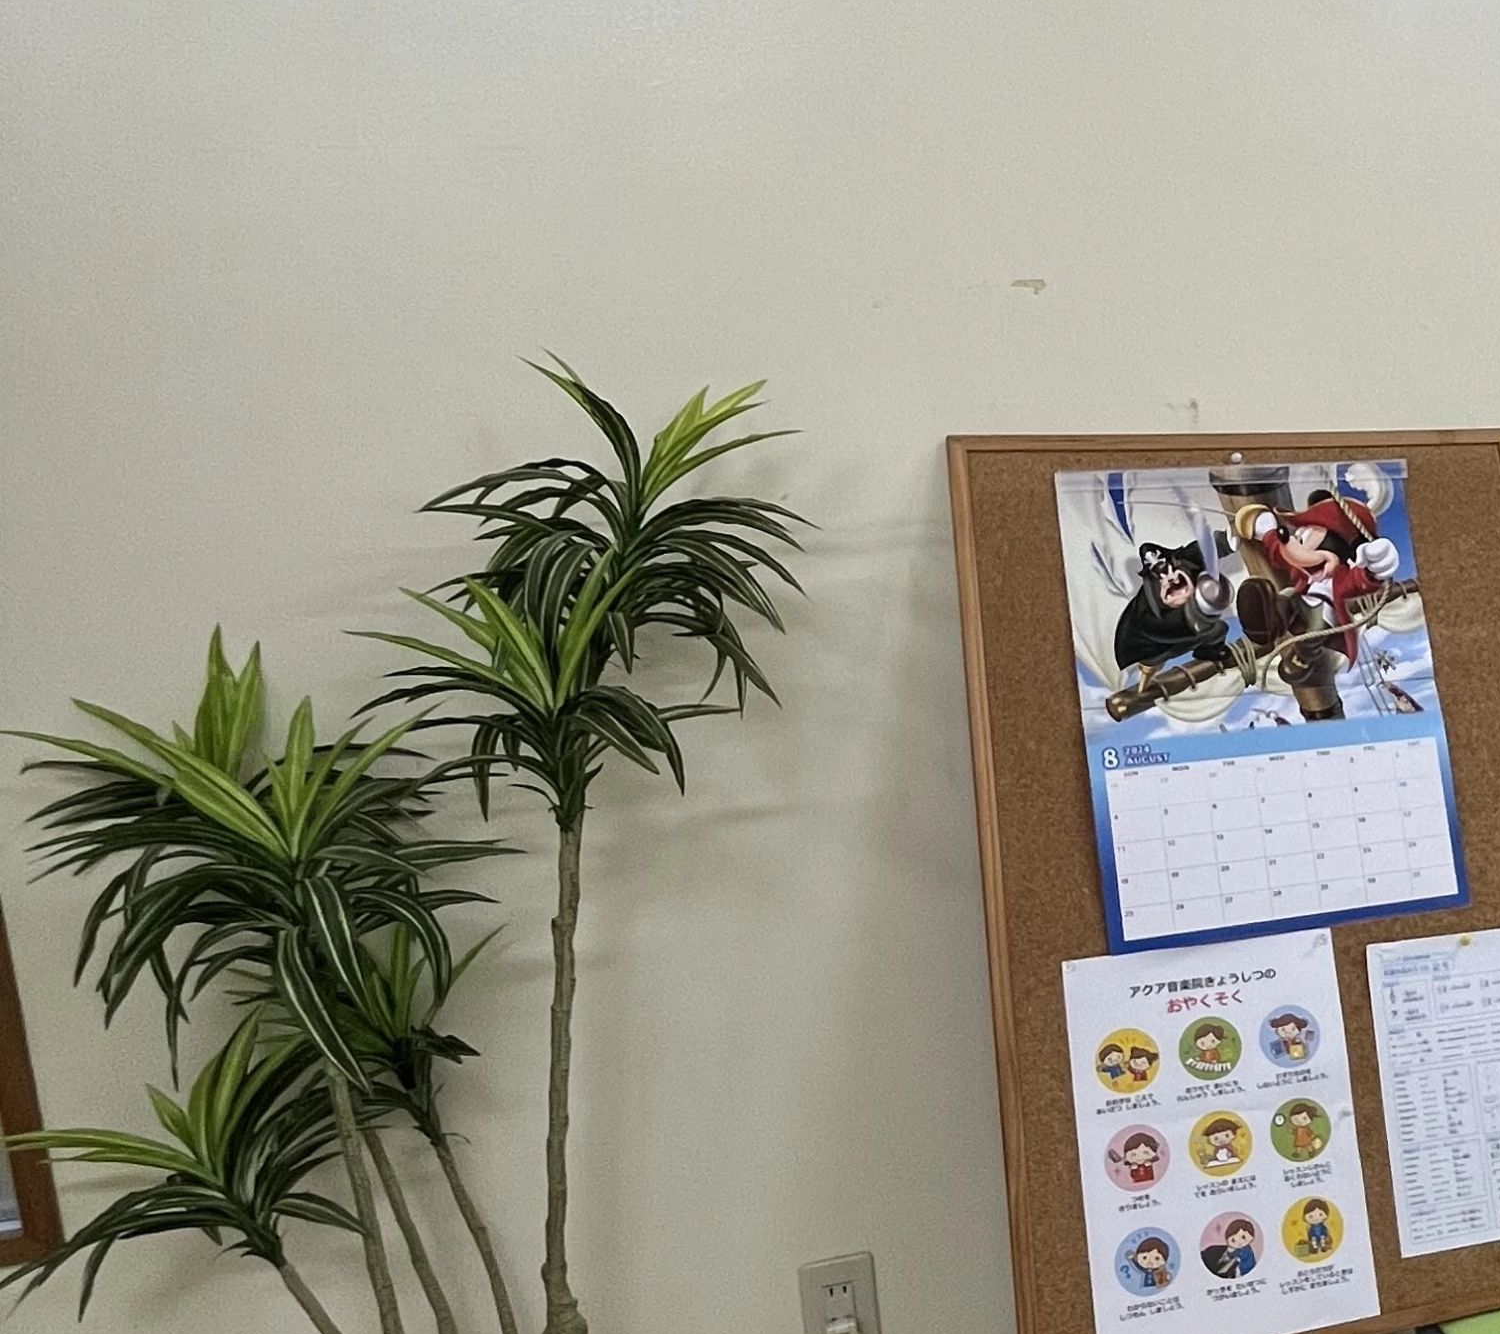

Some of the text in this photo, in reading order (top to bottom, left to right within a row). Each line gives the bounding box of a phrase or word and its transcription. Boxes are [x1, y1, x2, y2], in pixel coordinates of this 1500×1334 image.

[1102, 746, 1119, 769] 8
[1126, 753, 1169, 766] AUGUST
[1171, 764, 1190, 772] MON
[1167, 989, 1243, 1014] おやくそく
